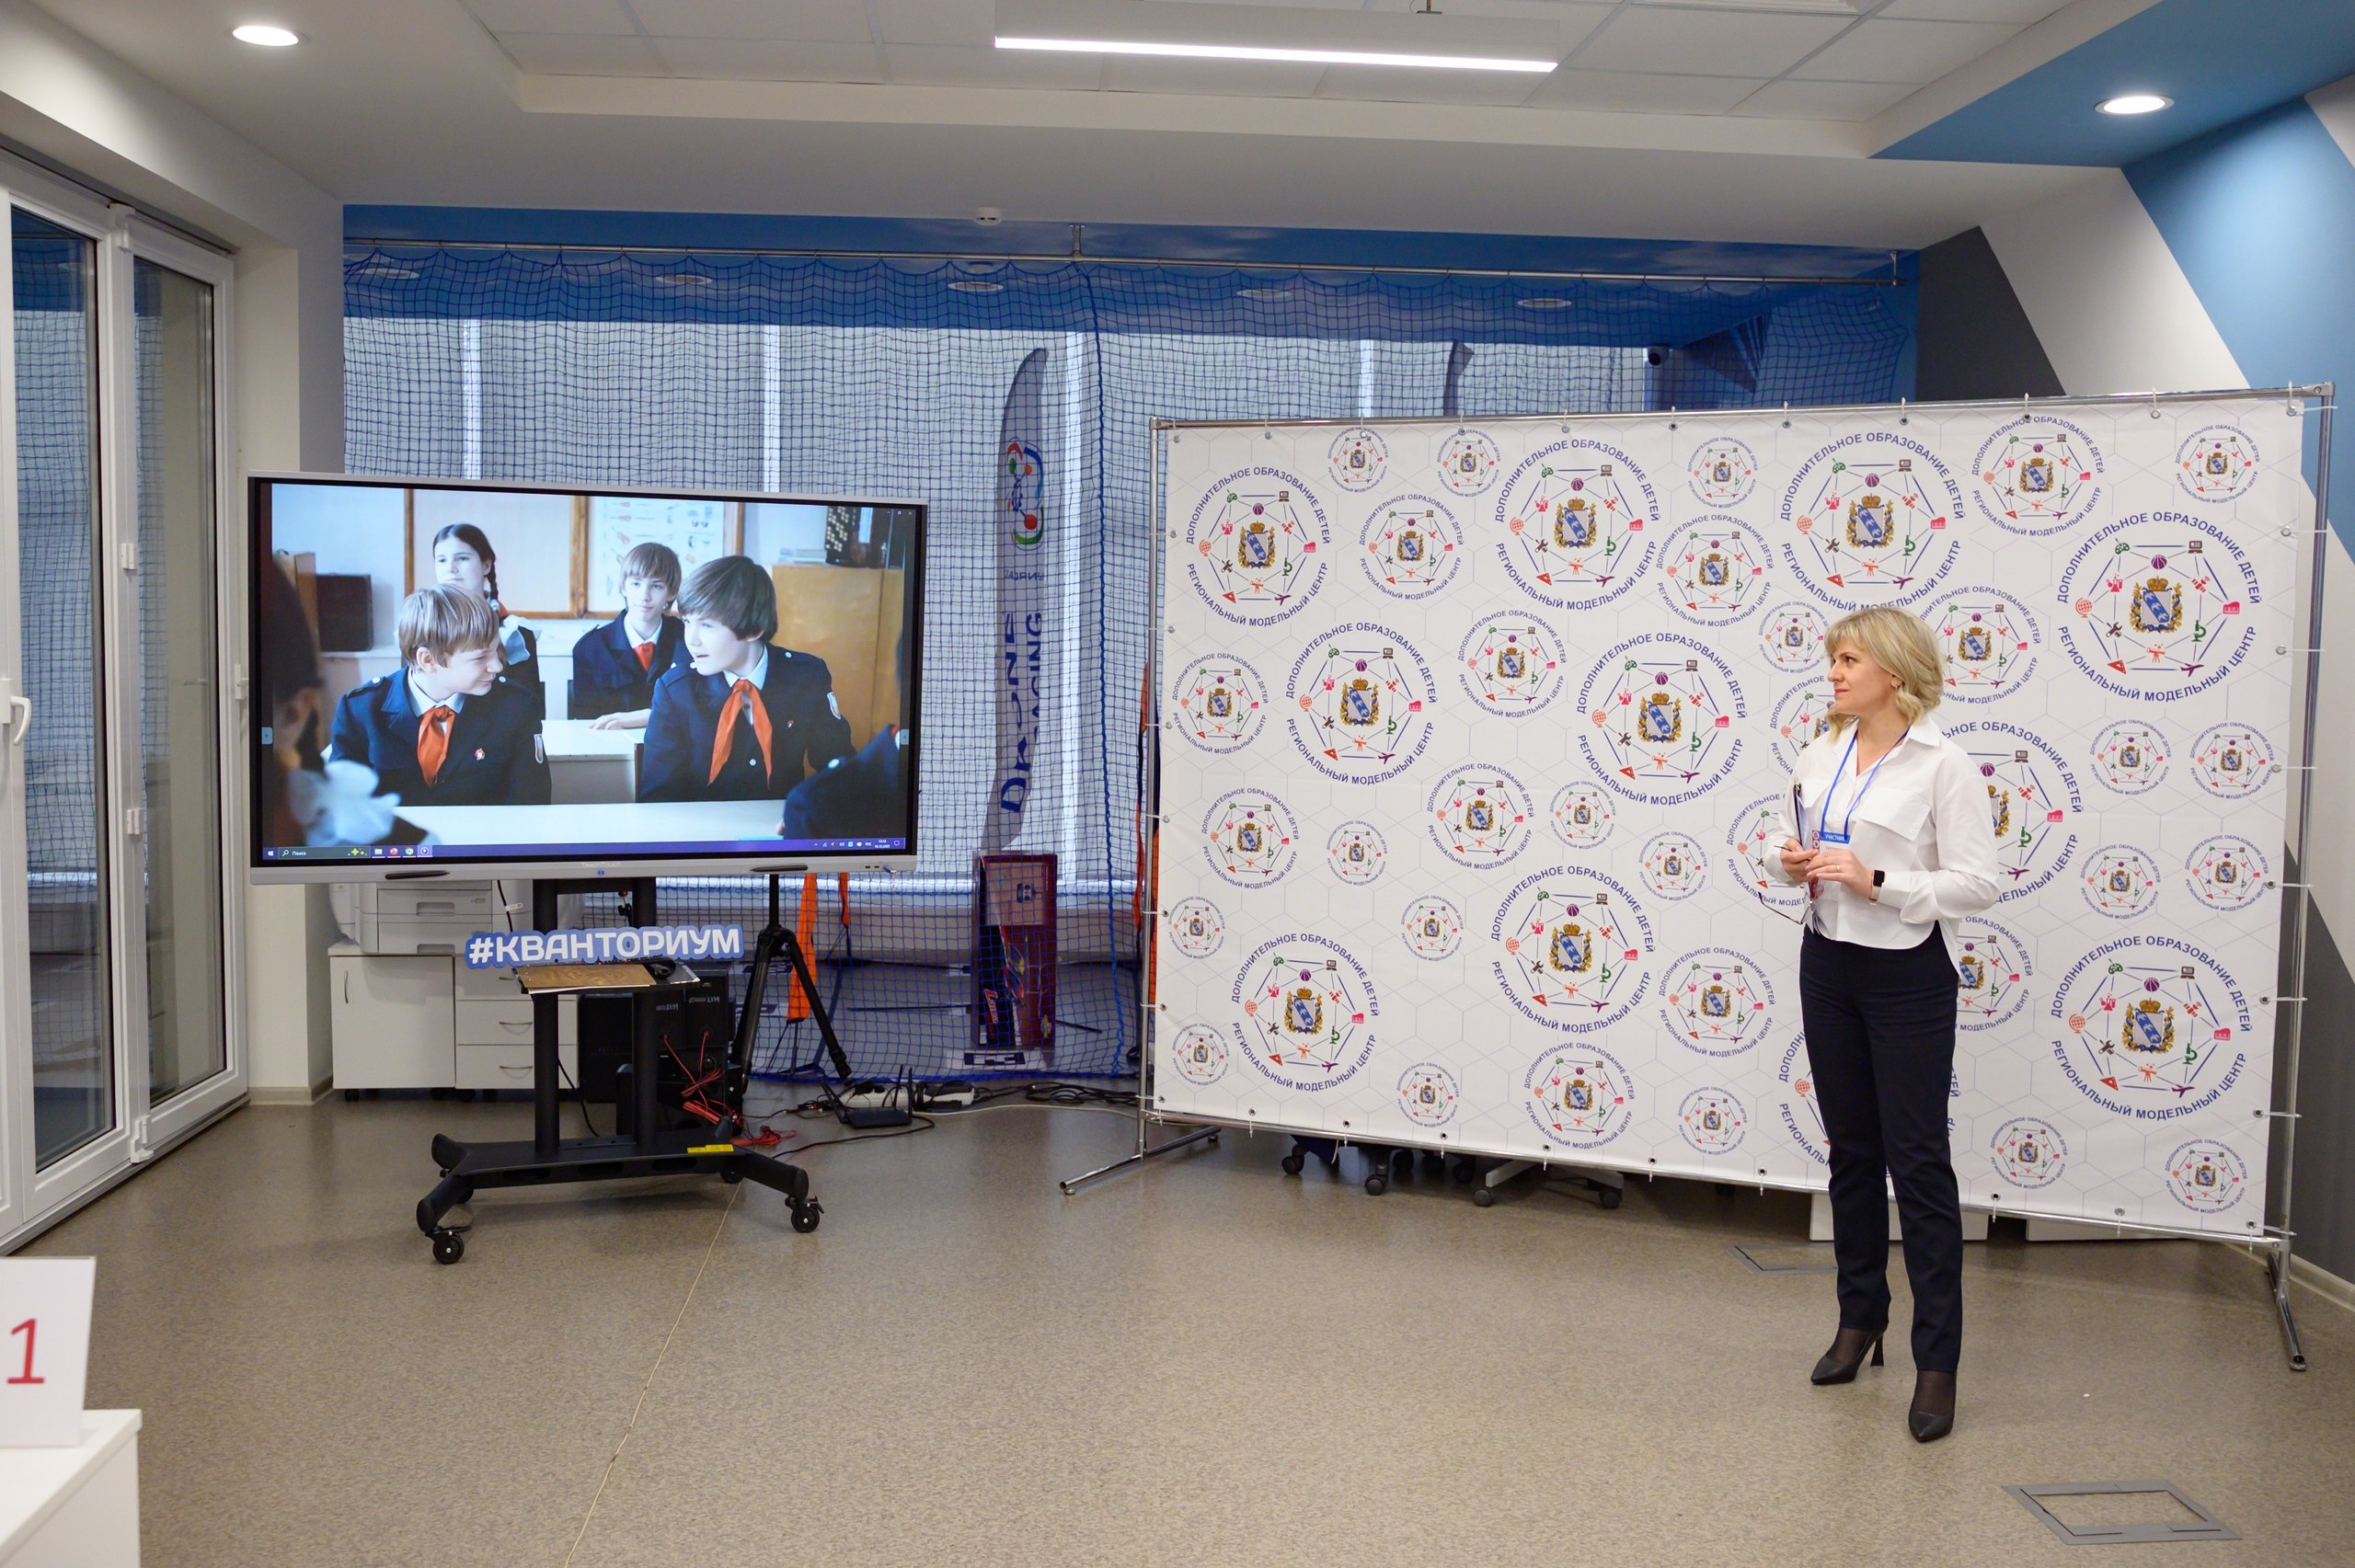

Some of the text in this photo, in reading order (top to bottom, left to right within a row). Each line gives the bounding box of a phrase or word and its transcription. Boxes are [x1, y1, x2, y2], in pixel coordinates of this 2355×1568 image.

[1972, 418, 2105, 476] ДОПОЛНИТЕЛЬНО ОБРАЗОВАНИЕ ДЕТЕЙ
[1187, 467, 1331, 544] ДОПОЛНИТЕЛЬНОЕ ОБРАЗОВАНИЕ ДЕТЕЙ
[1495, 440, 1660, 522] ДОПОЛНИТЕЛЬНОЕ ОБРАЗОВАНИЕ ДЕТЕЙ
[1781, 432, 1966, 521] ДОПОЛНИТЕЛЬНОЕ ОБРАЗОВАНИЕ ДЕТЕЙ
[1360, 494, 1465, 545] ДОПОЛНИТЕЛЬНОЕ ОБРАЗОВАНИЕ ДЕТЕЙ
[1973, 486, 2101, 536] РЕГИОНАЛЬНЫЙ МОДЕЛЬНЫЙ ЦЕНТР
[1657, 515, 1775, 569] ДОПОЛНИТЕЛЬНОЕ ОБРАЗОВАНИЕ ДЕТЕЙ
[2057, 512, 2262, 603] ДОПОЛНИТЕЛЬНОЕ ОБРАЗОВАНИЕ ДЕТЕЙ
[1188, 563, 1327, 627] РЕГИОНАЛЬНЫЙ МОДЕЛЬНЫЙ ЦЕНТР
[1360, 557, 1462, 601] РЕГИОНАЛЬНЫЙ МОДЕЛЬНЫЙ ЦЕНТР
[1496, 542, 1656, 611] РЕГИОНАЛЬНЫЙ МОДЕЛЬНЫЙ ЦЕНТР
[1658, 582, 1771, 627] РЕГИОНАЛЬНЫЙ МОДЕЛЬНЫЙ ЦЕНТР
[1782, 543, 1856, 612] РЕГИОНАЛЬНЫЙ
[1936, 541, 1960, 578] ЦЕНТР
[1458, 611, 1568, 663] ДОПОЛНИТЕЛЬНОЕ ОБРАЗОВАНИЕ ДЕТЕЙ
[1920, 586, 2041, 644] ЛНИТЕЛЬНОЕ ОБРАЗОВАНИЕ ДЕТЕЙ
[1172, 653, 1269, 704] ДОПОЛНИТЕЛЬНОЕ ОБРАЗОВАНИЕ ДЕТЕЙ
[1286, 623, 1438, 703] ДОПОЛНИТЕЛЬНОЕ ОБРАЗОВАНИЕ ДЕТЕЙ
[1577, 634, 1748, 718] ДОПОЛНИТЕЛЬНОЕ ОБРАЗОВАНИЕ ДЕТЕЙ
[1968, 681, 2022, 704] МОДЕЛЬНЫЙ
[2020, 658, 2038, 682] ЦЕНТР
[2058, 626, 2256, 703] РЕГИОНАЛЬНЫЙ МОДЕЛЬНЫЙ ЦЕНТР
[1459, 673, 1564, 718] РЕГИОНАЛЬНЫЙ МОДЕЛЬНЫЙ ЦЕНТР
[1770, 675, 1825, 729] ДОПОЛНИТЕЛЬНОЕ
[1173, 713, 1267, 755] РЕГИОНАЛЬНЫЙ МОДЕЛЬНЫЙ ЦЕНТР
[1287, 718, 1433, 785] РЕГИОНАЛЬНЫЙ МОДЕЛЬНЫЙ ЦЕНТР
[1771, 742, 1794, 775] РЕГИОНА
[1428, 763, 1535, 818] ДОПОЛНИТЕЛЬНОЕ ОБРАЗОВАНИЕ ДЕТЕЙ
[1578, 735, 1742, 806] РЕГИОНАЛЬНЫЙ МОДЕЛЬНЫЙ ЦЕНТР
[1982, 721, 2084, 813] ОБРАЗОВАНИЕ ДЕТЕЙ
[1201, 788, 1300, 840] ДОПОЛНИТЕЛЬНОЕ ОБРАЗОВАНИЕ ДЕТЕЙ
[1727, 794, 1780, 845] ДОПОЛНИТЕЛЬНОЕ
[1202, 846, 1297, 889] РЕГИОНАЛЬНЫЙ МОДЕЛЬНЫЙ ЦЕНТР
[1428, 825, 1532, 870] РЕГИОНАЛЬНЫЙ МОДЕЛЬНЫЙ ЦЕНТР
[2051, 835, 2077, 873] ЦЕНТР
[1491, 866, 1656, 953] ДОПОЛНИТЕЛЬНОЕ ОБРАЗОВАНИЕ ДЕТЕЙ
[468, 927, 741, 965] #КВАНТОРИУМ
[1232, 933, 1380, 1016] ДОПОЛНИТЕЛЬНОЕ ОБРАЗОВАНИЕ ДЕТЕЙ
[1966, 916, 2033, 976] ОБРАЗОВАНИЕ ДЕТЕЙ
[1492, 961, 1651, 1034] РЕГИОНАЛЬНЫЙ МОДЕЛЬНЫЙ ЦЕНТР
[1660, 947, 1776, 1005] ДОПОЛНИТЕЛЬНОЕ ОБРАЗОВАНИЕ ДЕТЕЙ
[2051, 936, 2252, 1032] ДОПОЛНИТЕЛЬНОЕ ОБРАЗОВАНИЕ ДЕТЕЙ
[1660, 1009, 1706, 1055] РЕГИОНАЛЬНЫЙ
[1709, 1039, 1758, 1058] МОДЕЛЬНЫЙ
[1756, 1017, 1773, 1040] ЦЕНТР
[1960, 990, 2029, 1032] МОДЕЛЬНЫЙ ЦЕНТР
[1233, 1023, 1375, 1093] РЕГИОНАЛЬНЫЙ МОДЕЛЬНЫЙ ЦЕНТР
[1524, 1043, 1636, 1099] ДОПОЛНИТЕЛЬНОЕ ОБРАЗОВАНИЕ ДЕТЕЙ
[2051, 1040, 2246, 1121] РЕГИОНАЛЬНЫЙ МОДЕЛЬНЫЙ ЦЕНТР
[1525, 1102, 1633, 1150] РЕГИОНАЛЬНЫЙ МОДЕЛЬНЫЙ ЦЕНТР
[1779, 1104, 1830, 1167] РЕГИОНАЛЬ
[6, 1318, 46, 1385] 1
